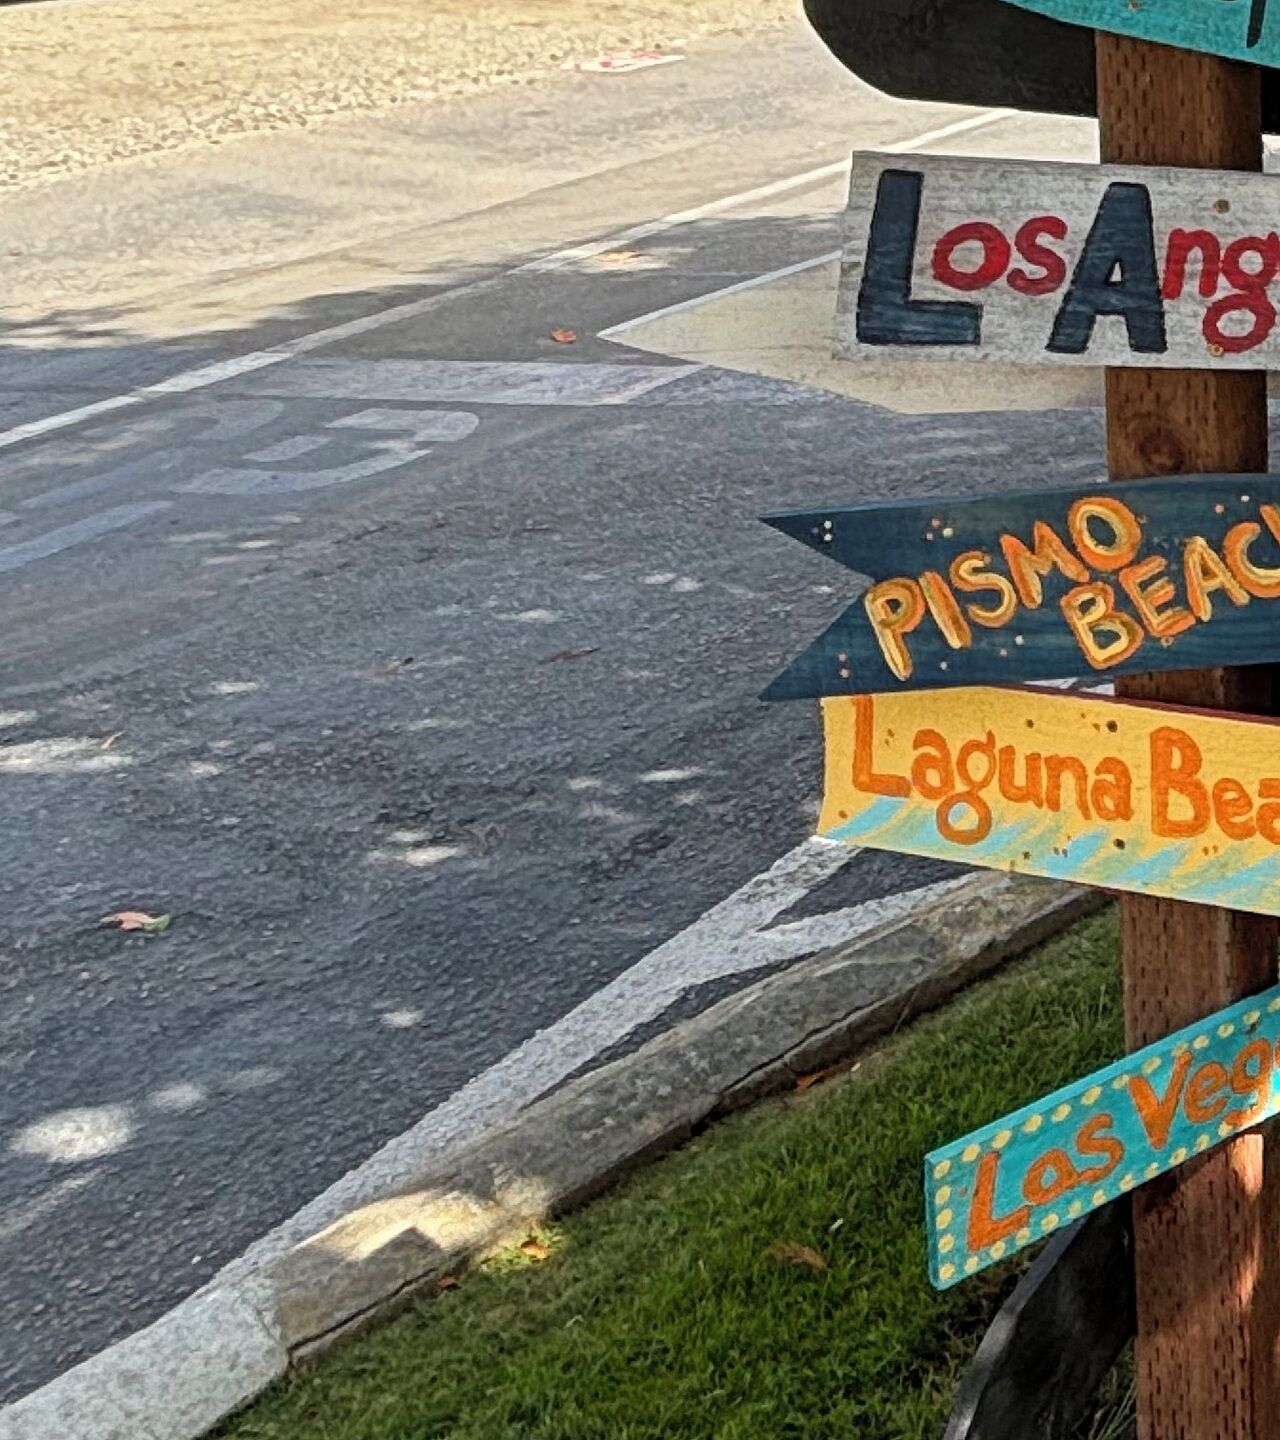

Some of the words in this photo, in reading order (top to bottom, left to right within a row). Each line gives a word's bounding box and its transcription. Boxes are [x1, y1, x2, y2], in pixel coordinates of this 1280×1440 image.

[864, 496, 1143, 682] PISMO
[851, 695, 1135, 845] Laguna
[967, 1113, 1125, 1252] Las
